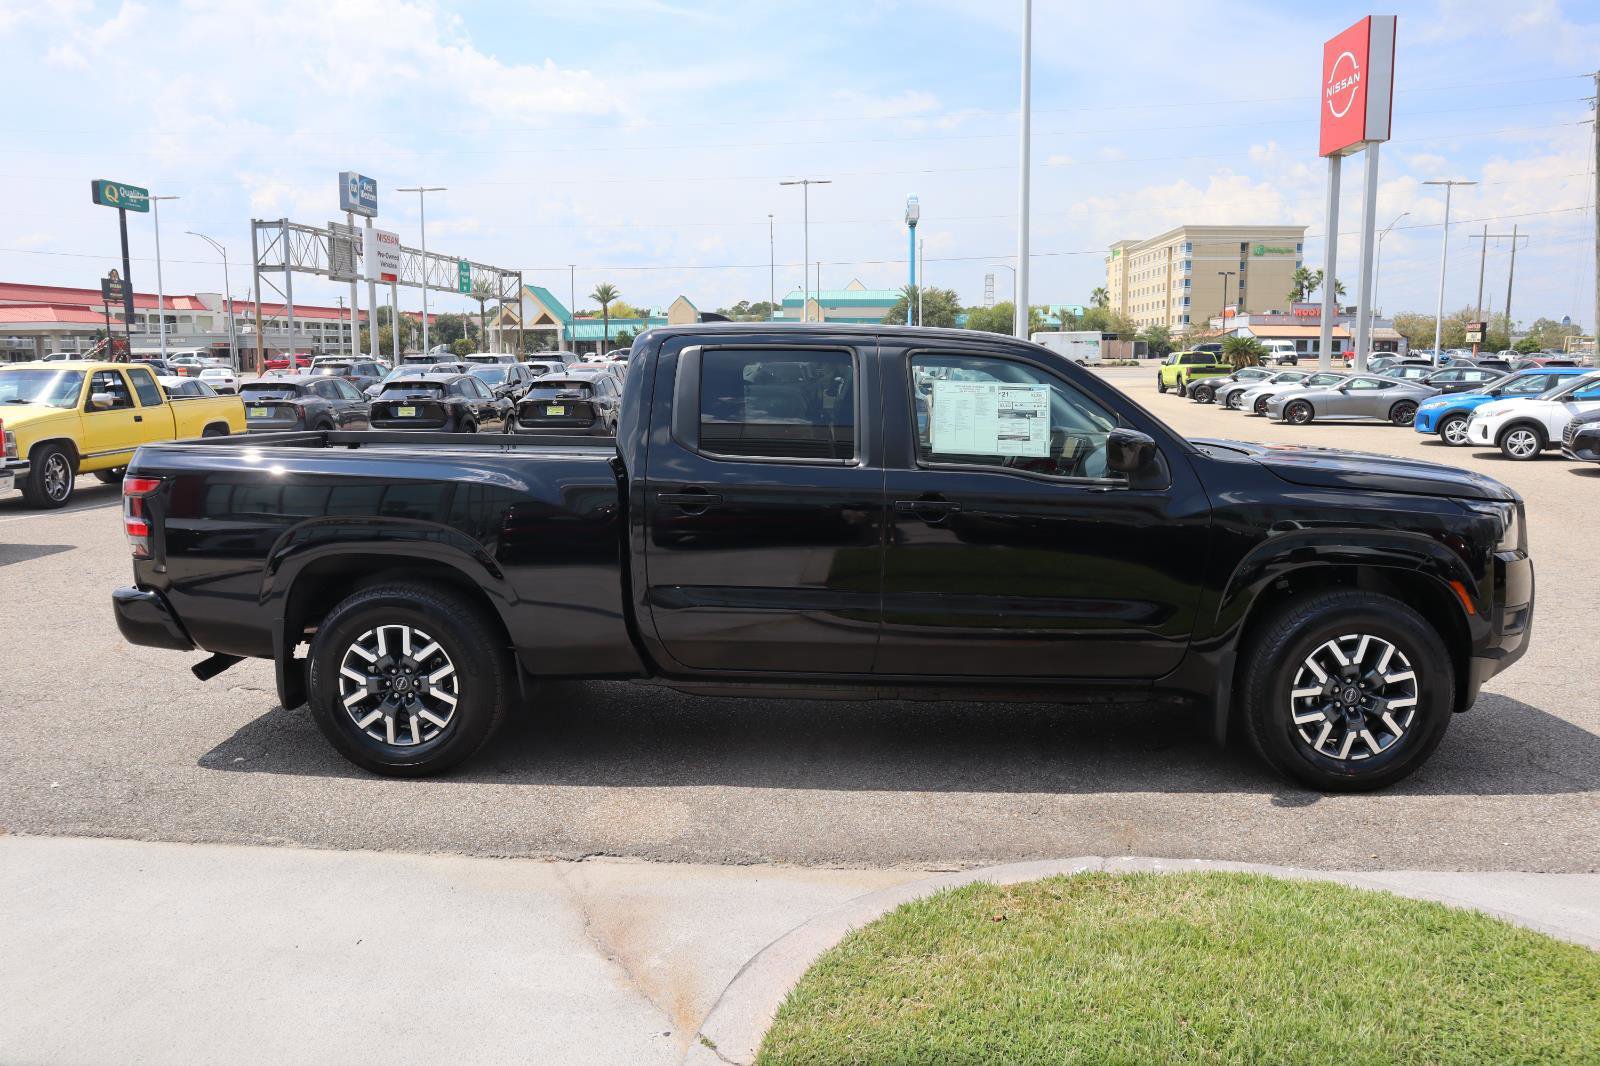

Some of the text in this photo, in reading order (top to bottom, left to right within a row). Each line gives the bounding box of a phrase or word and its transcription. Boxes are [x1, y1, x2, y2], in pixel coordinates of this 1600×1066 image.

[1326, 72, 1360, 98] NISSAN
[119, 187, 144, 201] Quality
[376, 233, 399, 245] NISSAN
[377, 250, 400, 261] Pre-Owned
[380, 261, 398, 270] Vehicles
